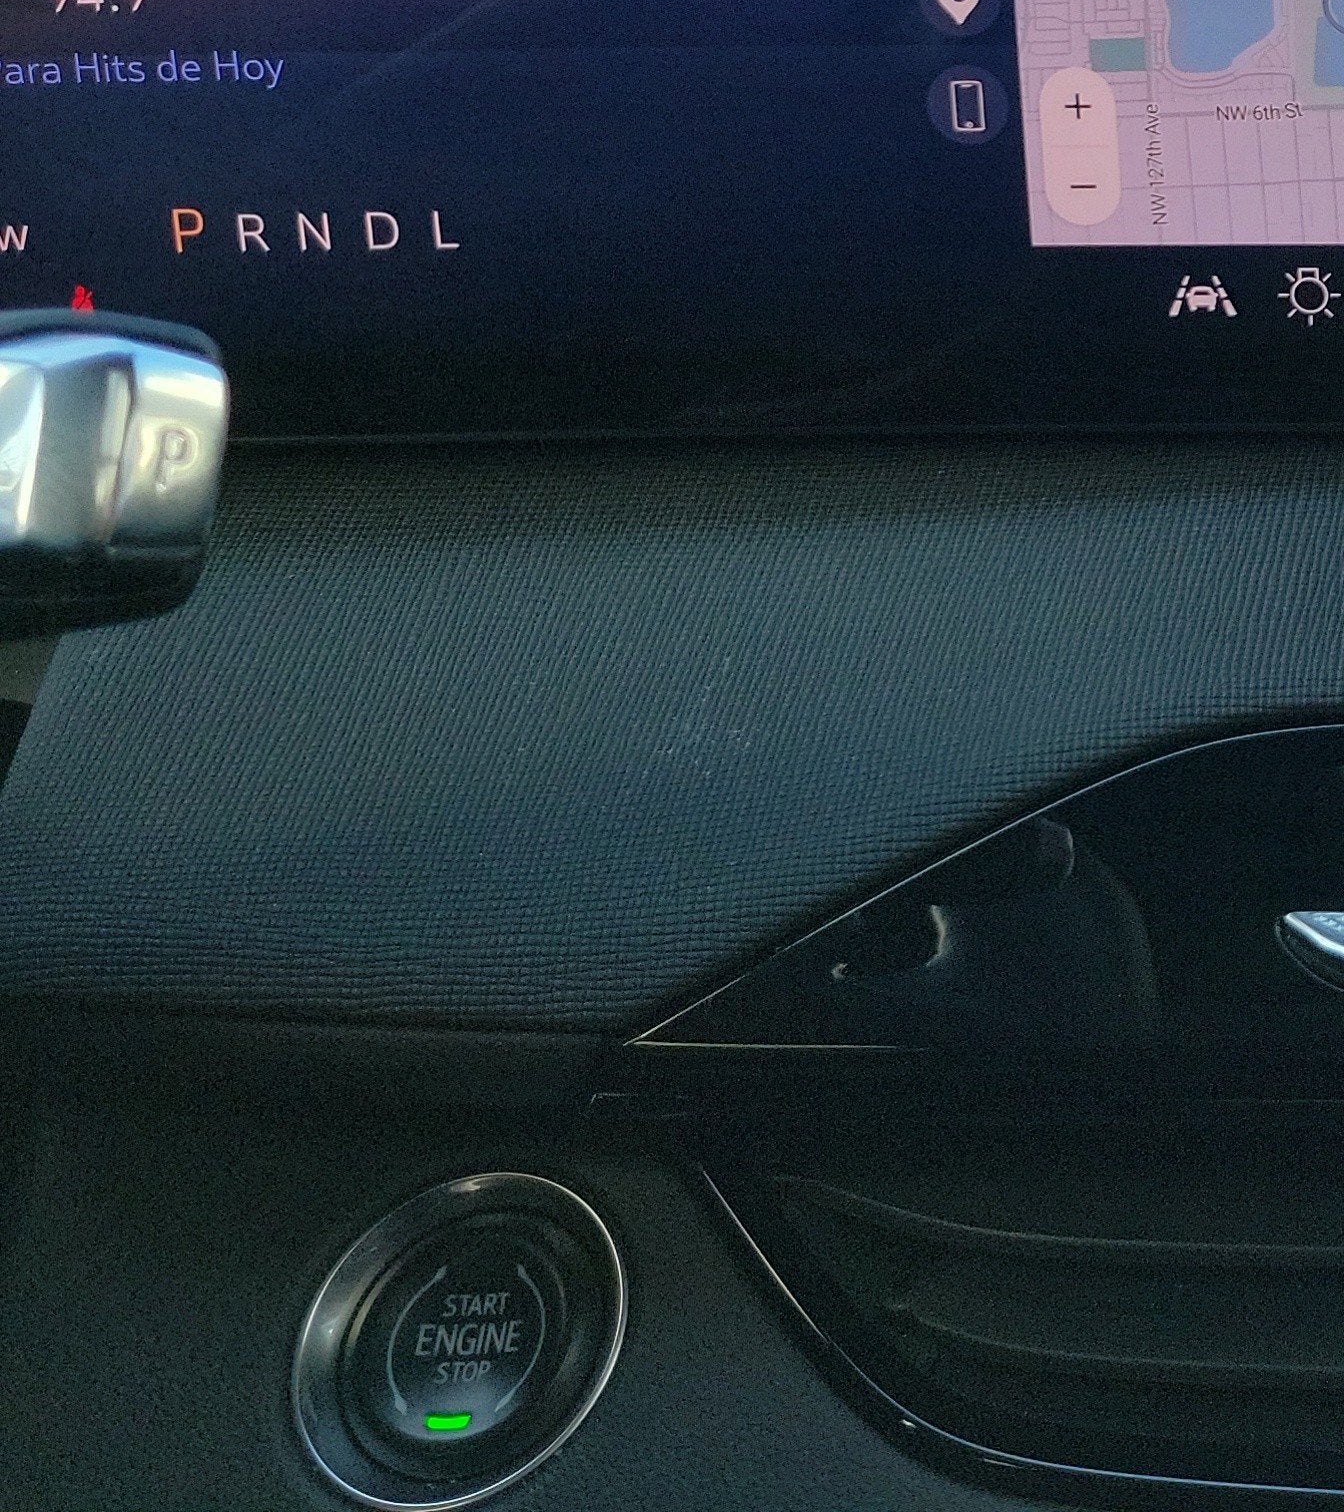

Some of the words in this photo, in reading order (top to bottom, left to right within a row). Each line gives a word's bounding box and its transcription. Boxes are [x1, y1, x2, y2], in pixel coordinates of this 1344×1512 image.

[0, 60, 62, 85] ara
[73, 52, 146, 83] Hits
[156, 49, 201, 82] de
[213, 50, 285, 89] Hoy
[1145, 103, 1163, 135] Ave
[1216, 104, 1248, 121] NW
[1253, 103, 1282, 120] 6th
[1284, 103, 1304, 118] St
[1147, 137, 1167, 189] 127th
[1151, 192, 1170, 226] NW
[170, 207, 204, 254] P
[442, 1292, 510, 1317] START
[415, 1320, 522, 1356] ENGINE
[433, 1360, 492, 1385] STOP
